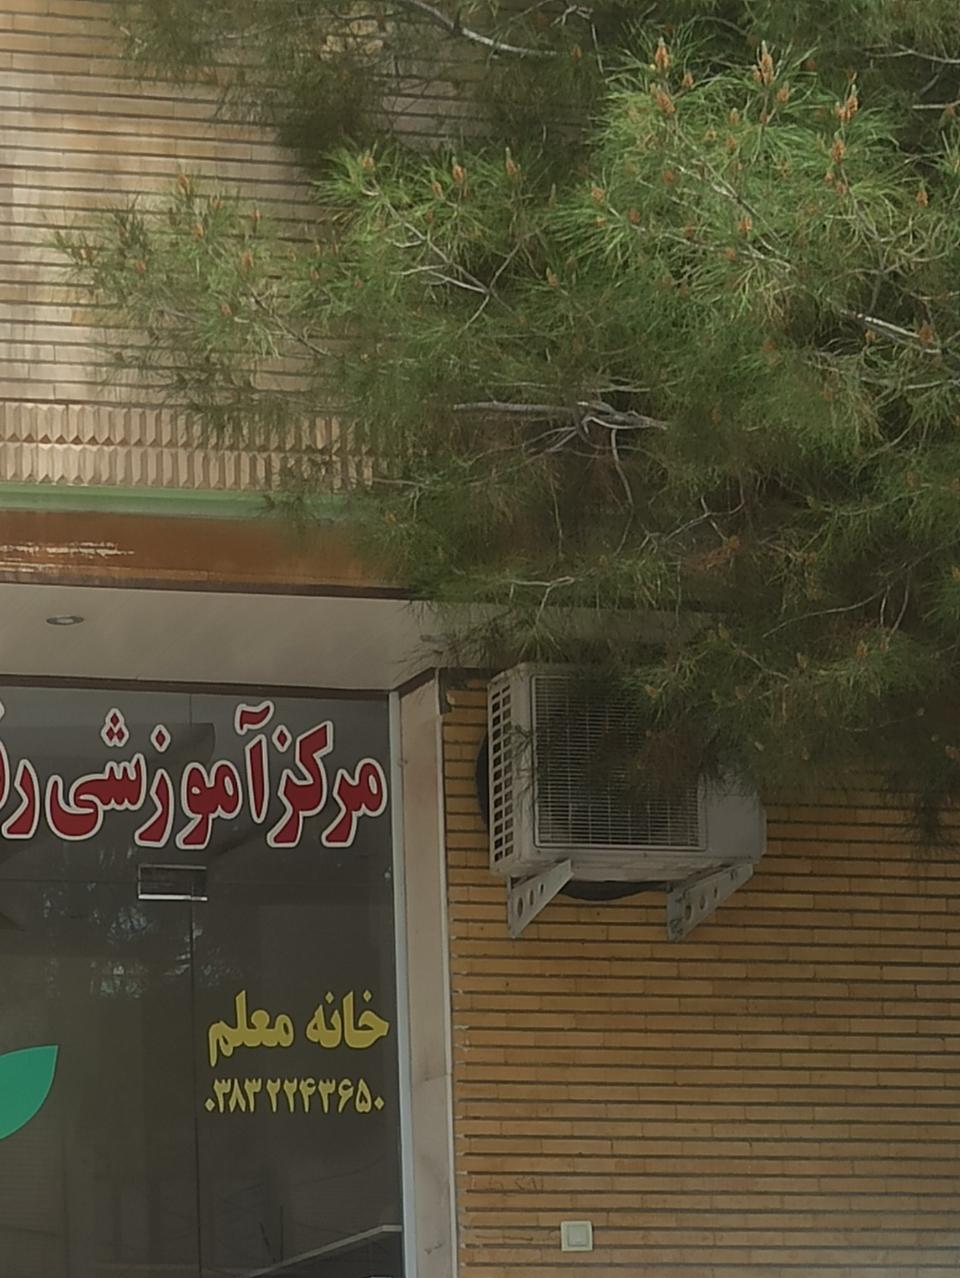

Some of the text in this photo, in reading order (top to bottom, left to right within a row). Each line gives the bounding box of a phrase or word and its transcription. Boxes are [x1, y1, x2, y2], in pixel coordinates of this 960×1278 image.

[45, 701, 275, 849] آموزشی
[268, 720, 388, 849] مرکز
[208, 989, 390, 1068] خانه معلم
